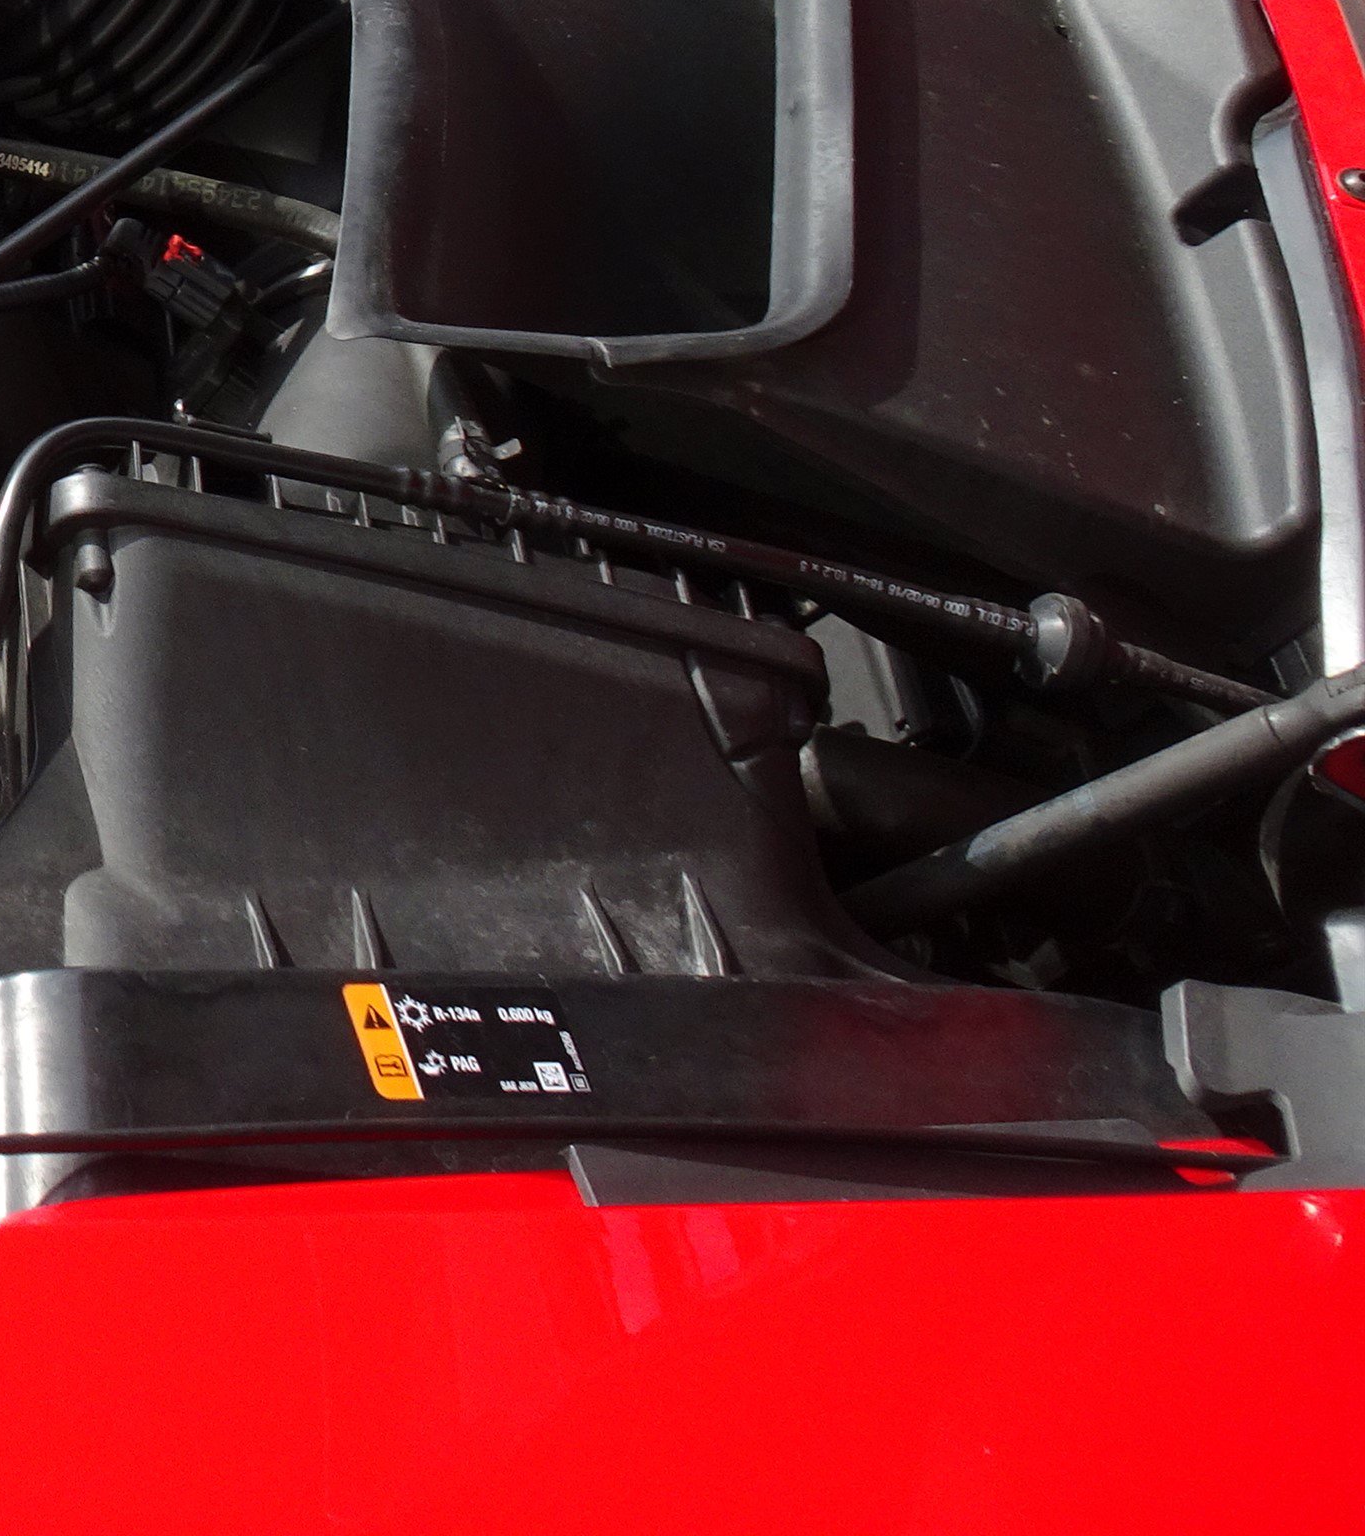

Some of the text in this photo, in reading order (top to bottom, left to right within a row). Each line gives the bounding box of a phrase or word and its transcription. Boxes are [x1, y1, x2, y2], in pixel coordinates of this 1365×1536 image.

[944, 599, 972, 618] 1000
[431, 1005, 556, 1026] R-134a 0.600 kg
[450, 1055, 481, 1073] PAG
